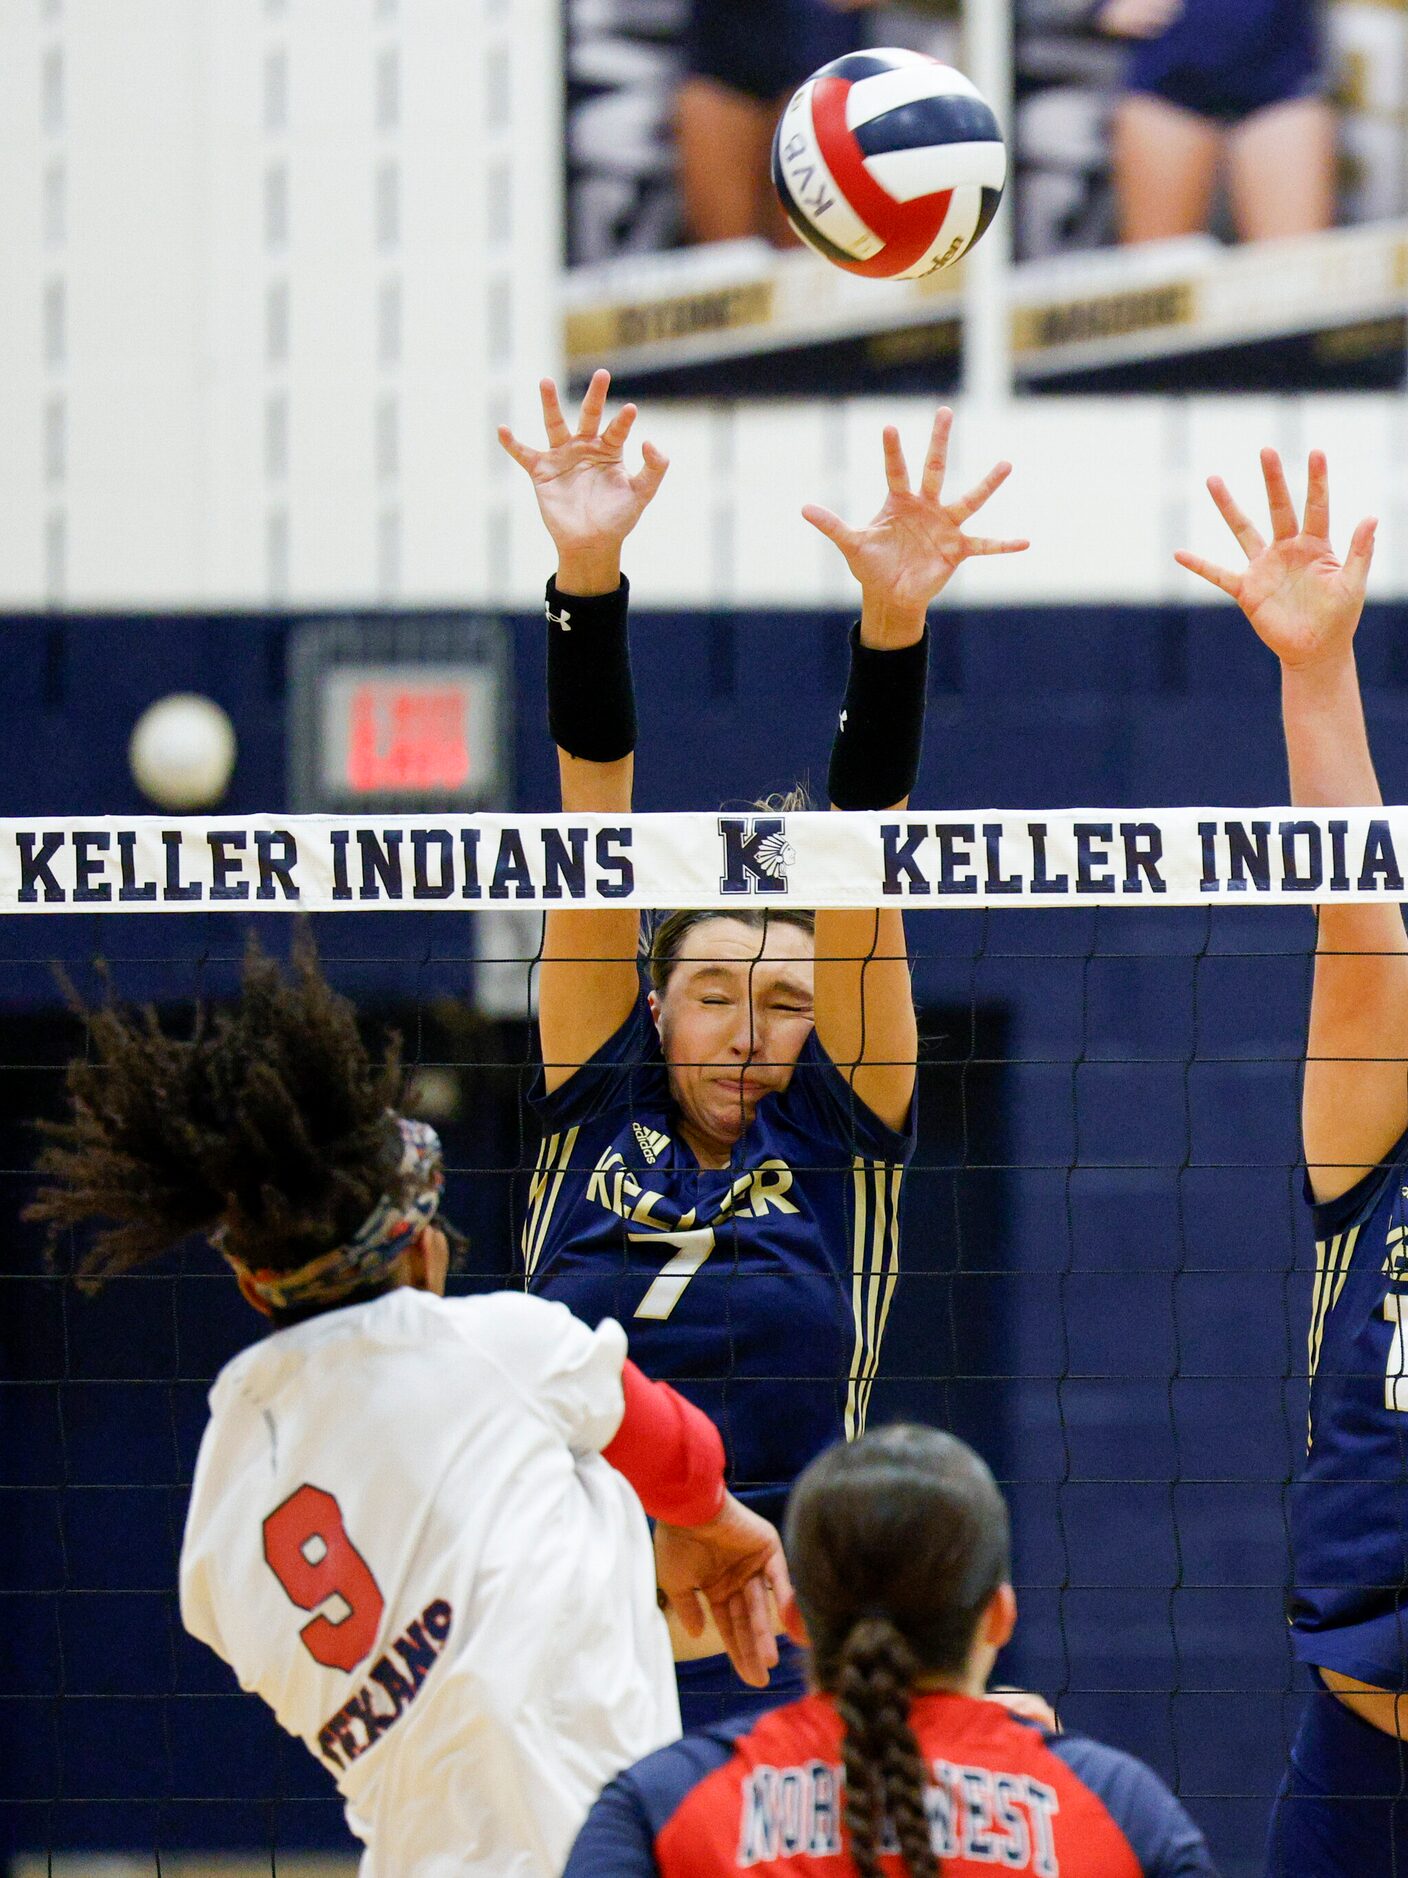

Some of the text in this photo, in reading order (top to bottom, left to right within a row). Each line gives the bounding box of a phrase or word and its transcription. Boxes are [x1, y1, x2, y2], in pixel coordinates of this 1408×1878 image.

[16, 827, 634, 902] KELLER INDIANS
[718, 818, 787, 895] K
[881, 823, 1166, 894] KELLER
[632, 1122, 656, 1164] adidas
[628, 1227, 715, 1320] 7
[261, 1482, 384, 1674] 9
